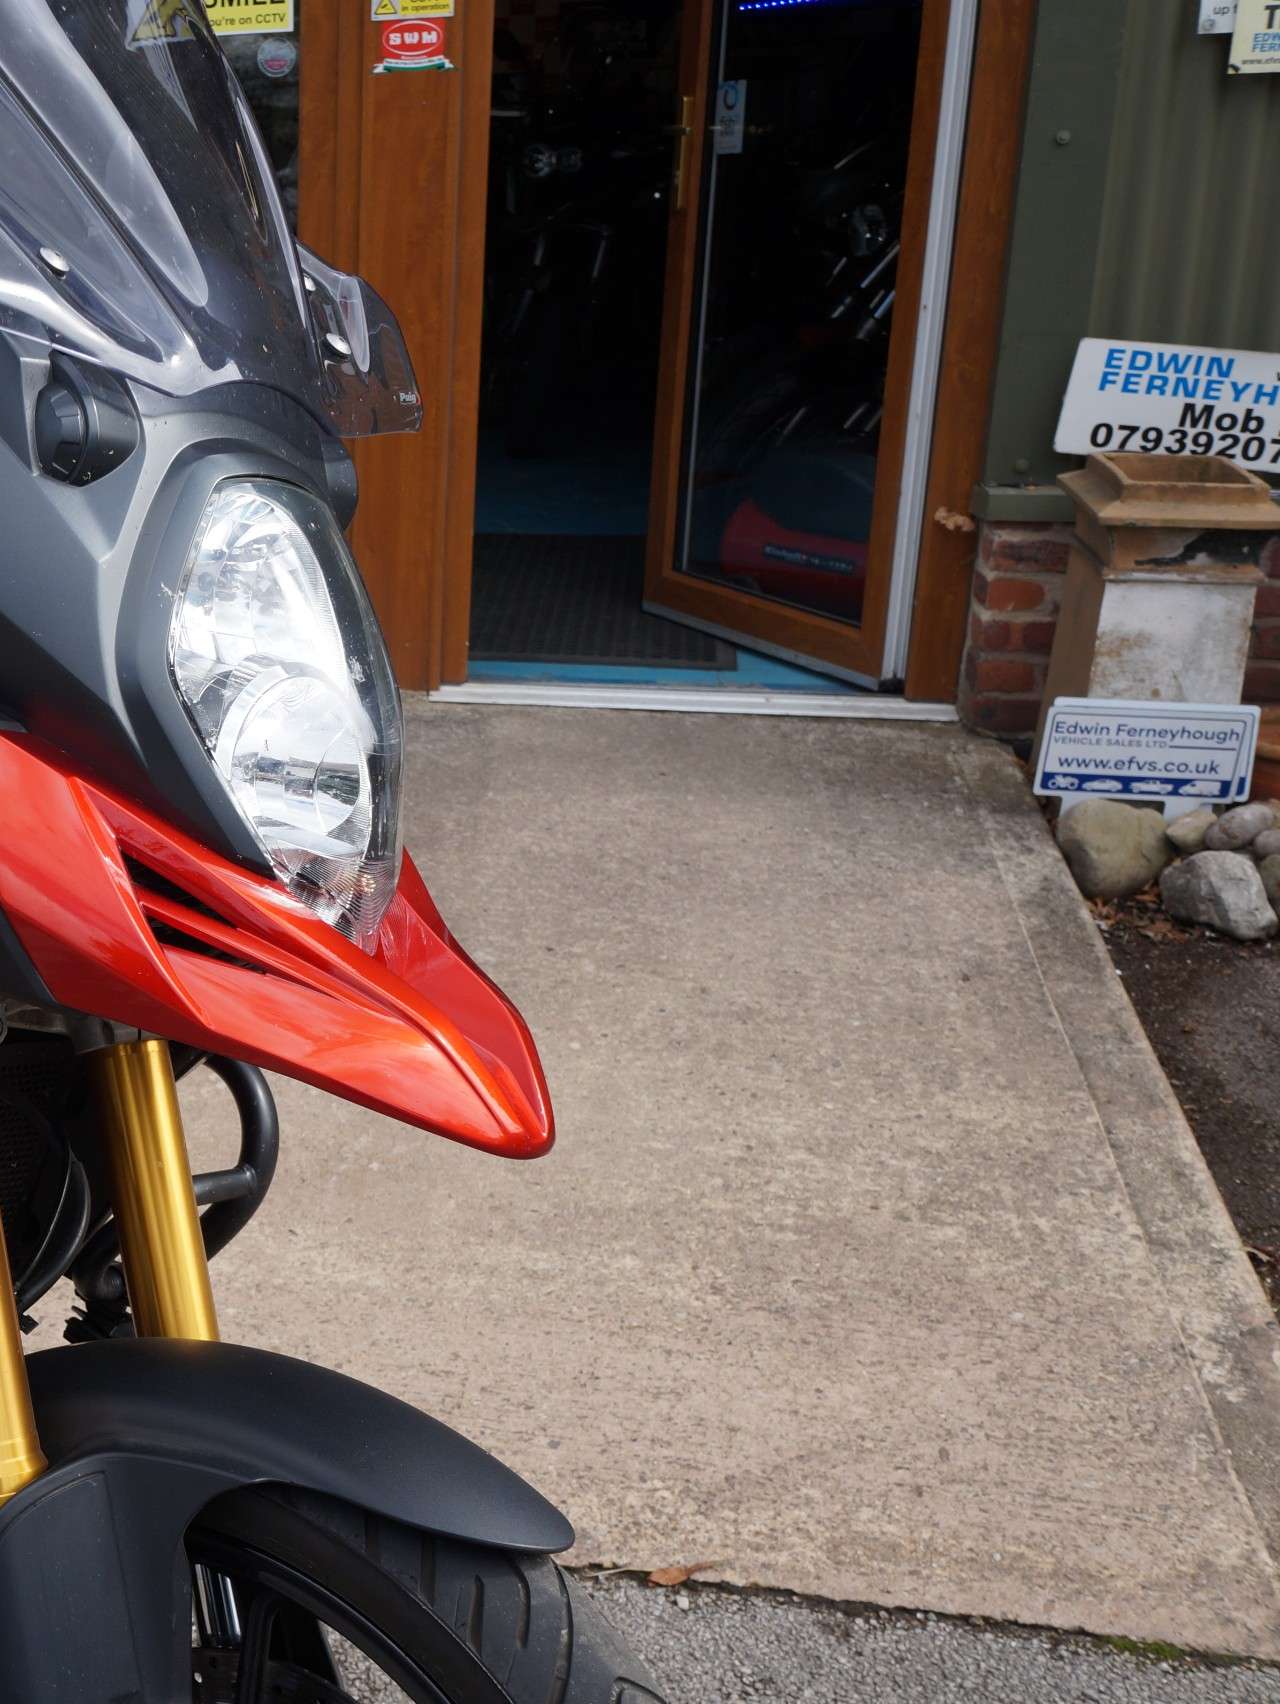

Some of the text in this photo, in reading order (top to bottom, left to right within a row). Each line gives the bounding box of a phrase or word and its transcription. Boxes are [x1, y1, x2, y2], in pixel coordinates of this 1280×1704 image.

[209, 13, 286, 27] ou're on CCTV
[1103, 348, 1236, 379] EDWIN
[1178, 402, 1265, 435] Mob
[1053, 735, 1168, 749] VEHICLE SALES LTD
[1054, 720, 1240, 745] Edwin Ferneyhough
[1057, 755, 1220, 775] www.efvs.co.uk
